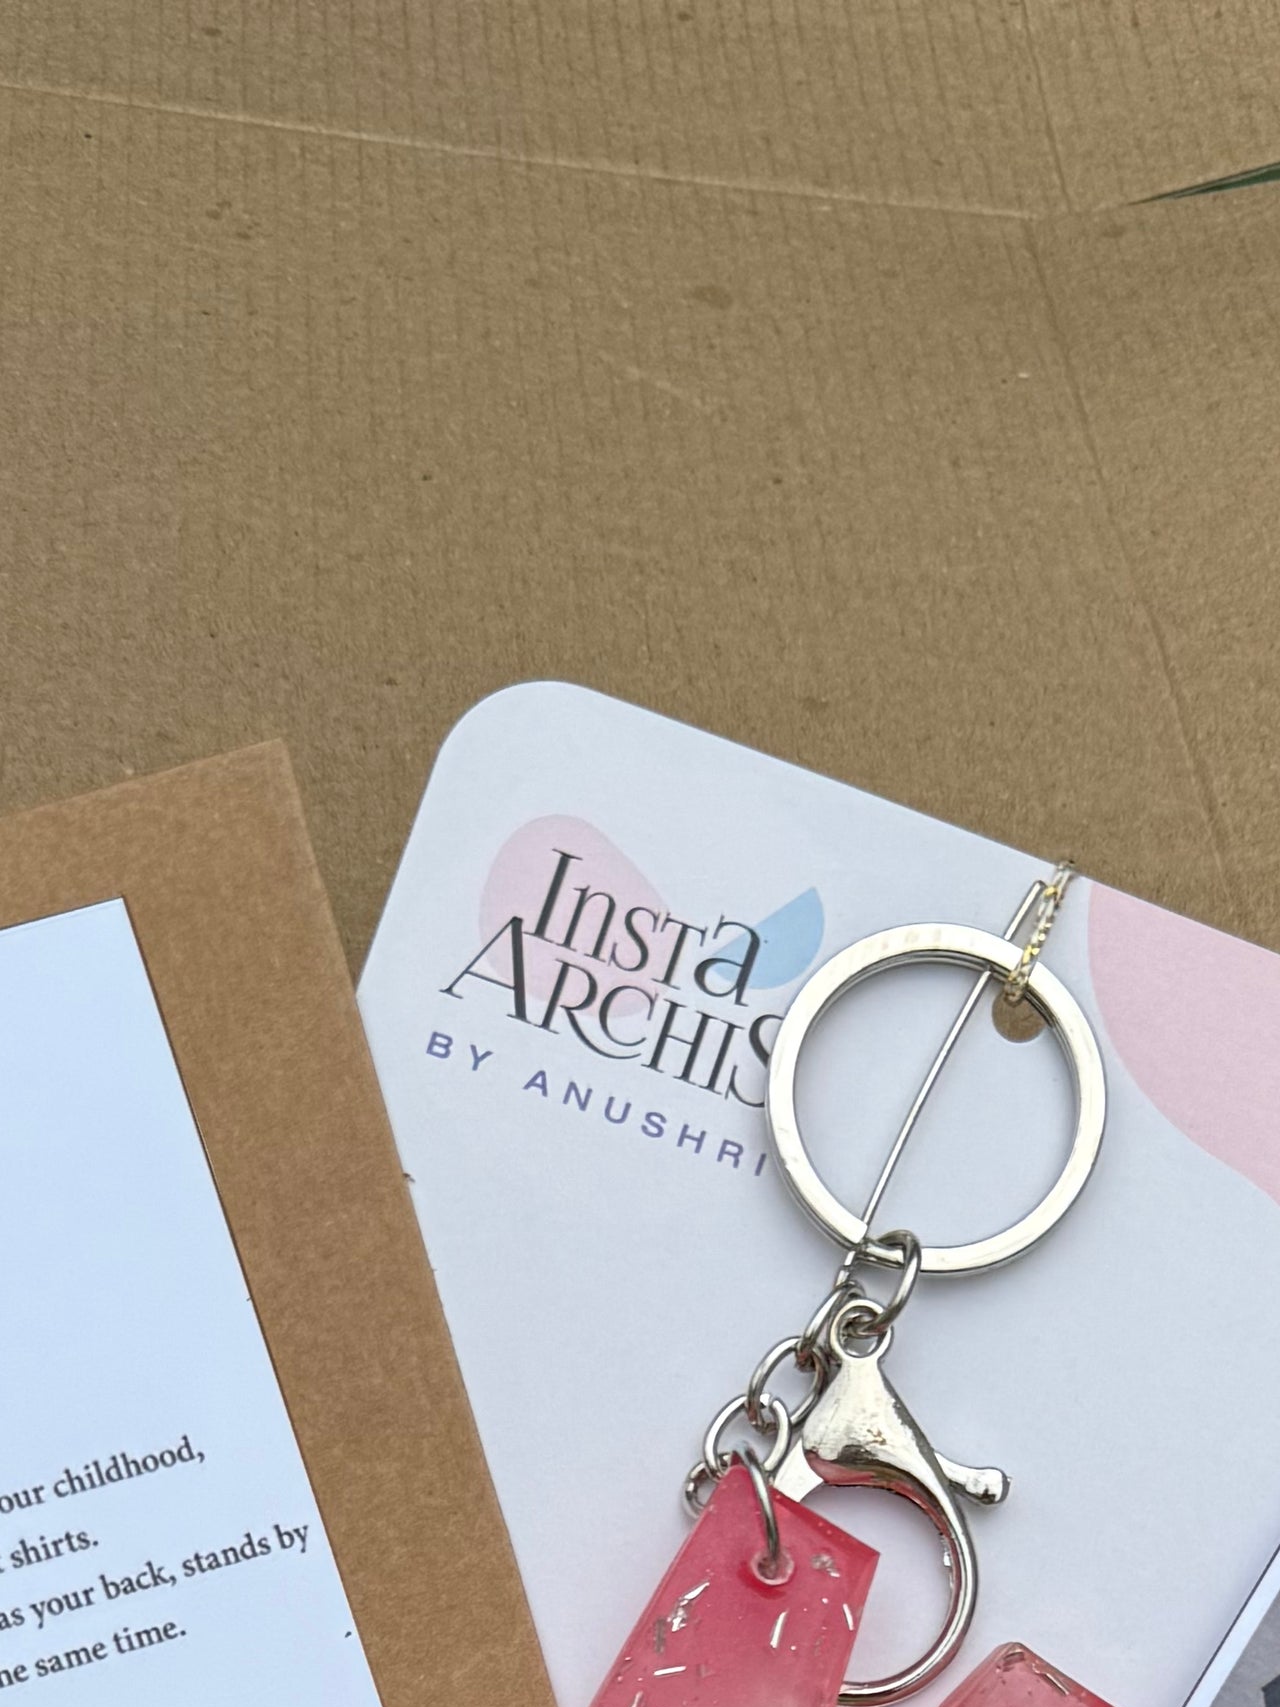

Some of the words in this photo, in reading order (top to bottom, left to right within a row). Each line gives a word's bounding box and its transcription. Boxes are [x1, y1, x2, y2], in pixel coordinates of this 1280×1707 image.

[438, 914, 784, 1110] ARCHIS
[425, 1031, 495, 1073] BY
[523, 1069, 769, 1178] ANUSHRI
[53, 1434, 205, 1498] childhood,
[10, 1531, 99, 1569] shirts.
[29, 1587, 94, 1629] your
[98, 1561, 177, 1600] back,
[182, 1532, 272, 1577] stands
[273, 1524, 308, 1554] by
[34, 1642, 108, 1677] same
[112, 1622, 187, 1654] time.
